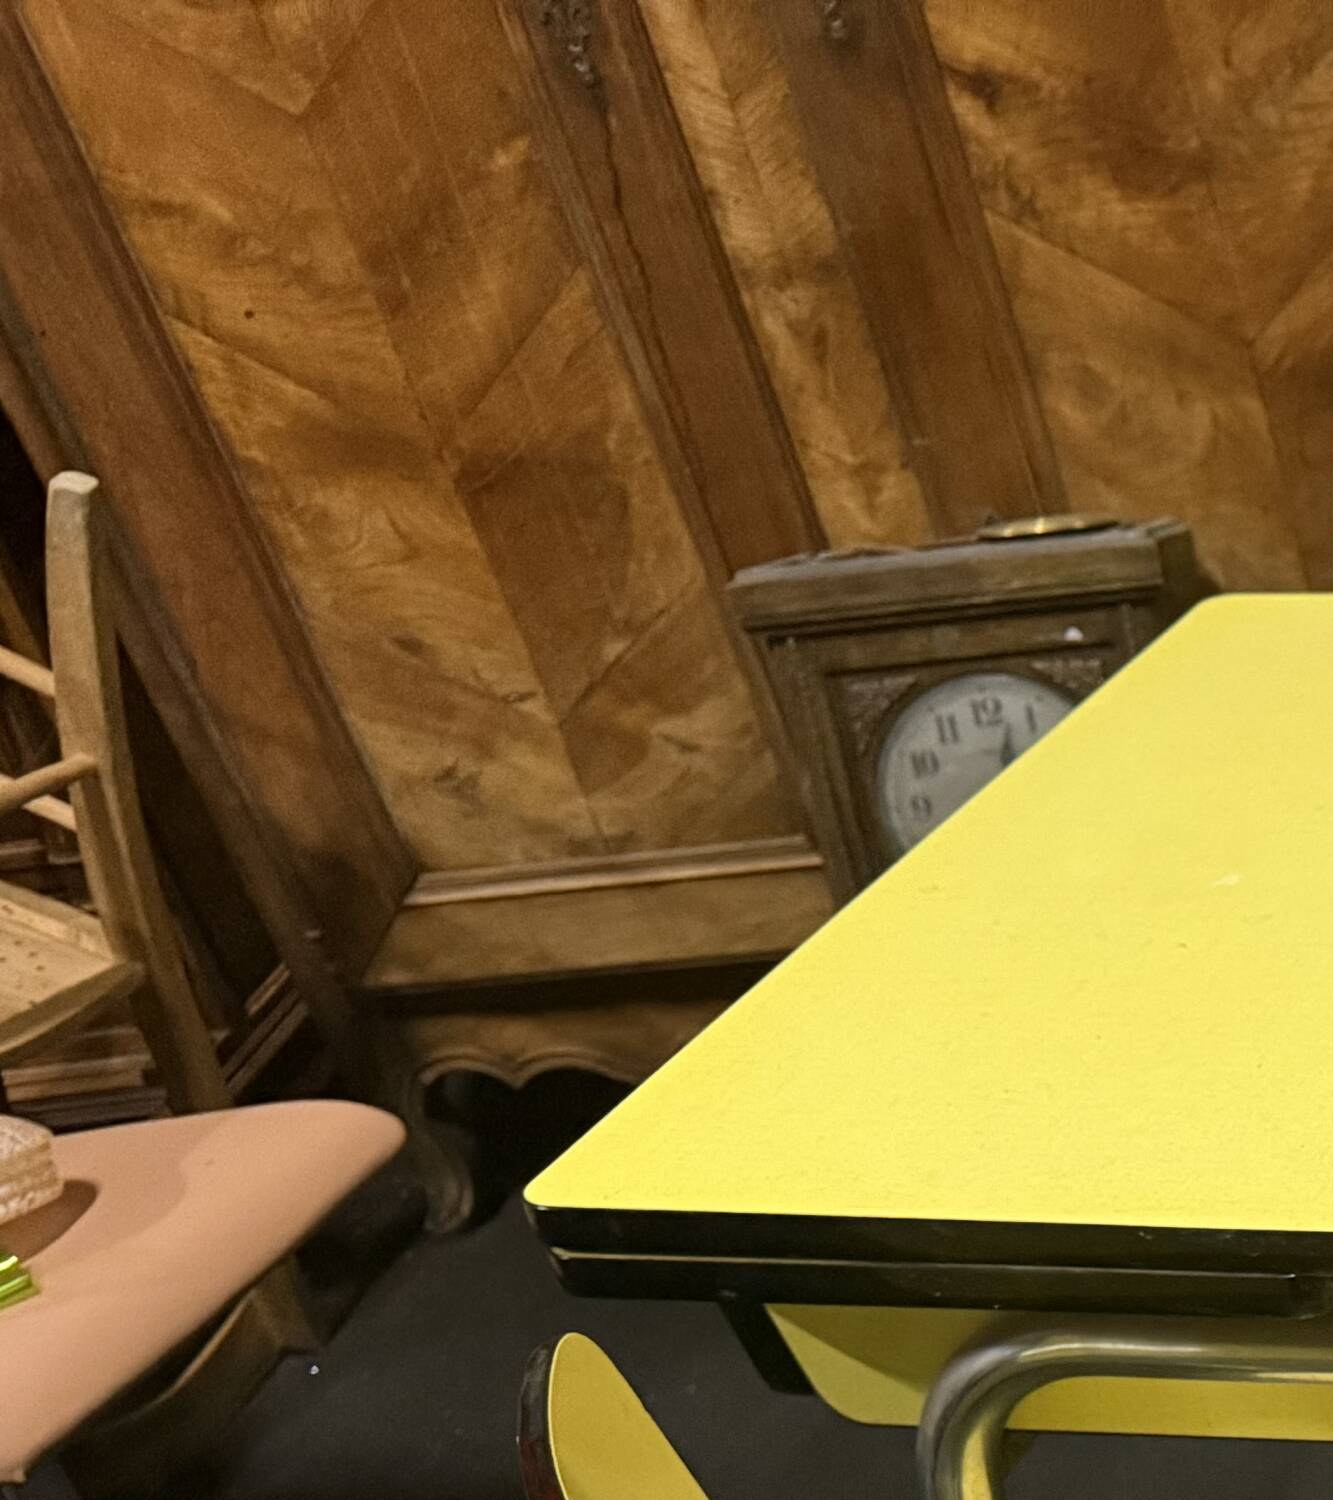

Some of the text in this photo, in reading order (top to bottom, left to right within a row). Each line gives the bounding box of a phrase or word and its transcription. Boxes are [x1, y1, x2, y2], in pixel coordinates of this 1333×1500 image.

[970, 697, 1003, 728] 12
[935, 714, 960, 745] 11
[910, 749, 940, 780] 10
[911, 796, 932, 820] 9
